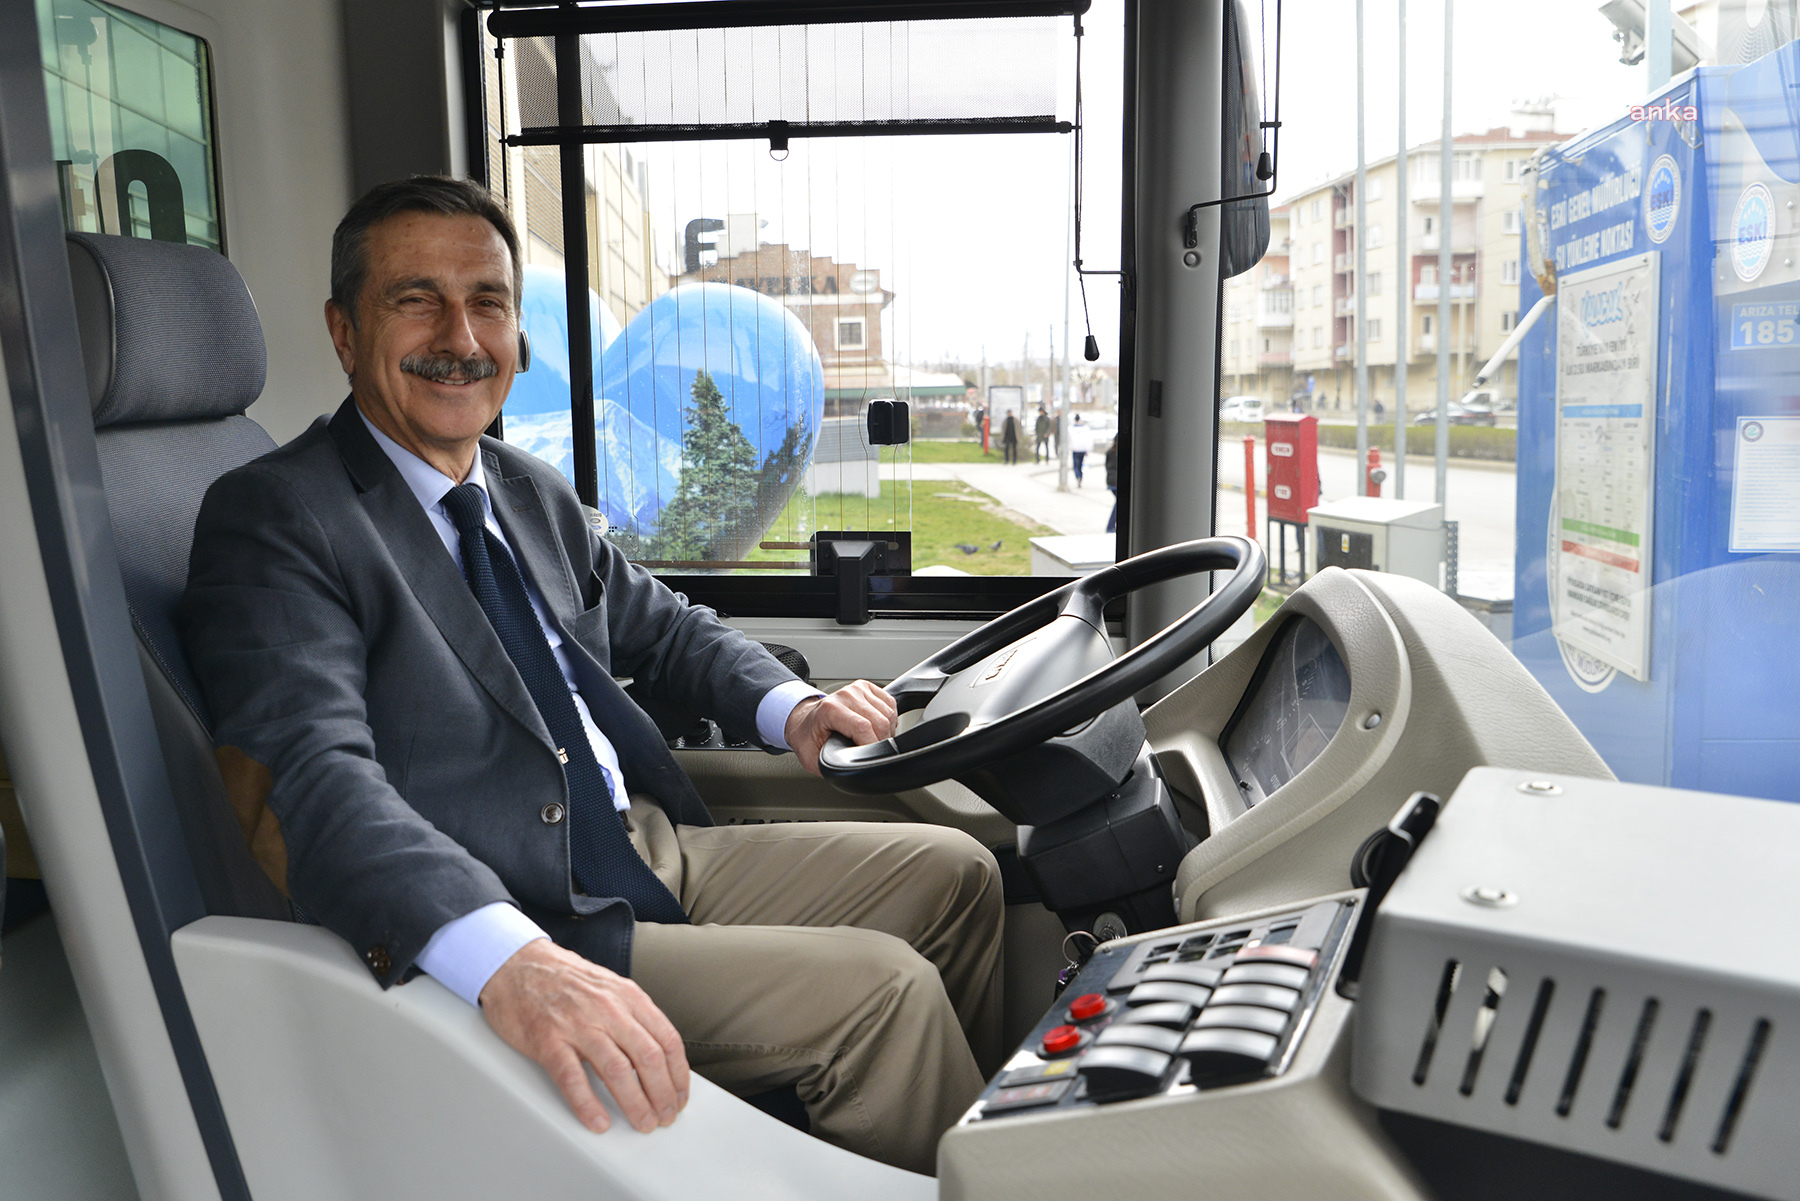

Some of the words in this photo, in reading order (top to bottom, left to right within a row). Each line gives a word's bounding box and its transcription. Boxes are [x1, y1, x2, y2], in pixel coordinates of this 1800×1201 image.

[1551, 194, 1567, 230] ESKİ
[1568, 190, 1591, 224] GENEL
[1650, 185, 1674, 212] ESKİ
[1738, 215, 1768, 245] ESKİ
[1555, 244, 1566, 271] SU
[1567, 231, 1600, 268] YÜKLEME
[1600, 219, 1634, 257] NOKTASI
[1739, 306, 1775, 317] ARIZA
[1778, 304, 1800, 316] TEL
[1740, 319, 1794, 345] 185
